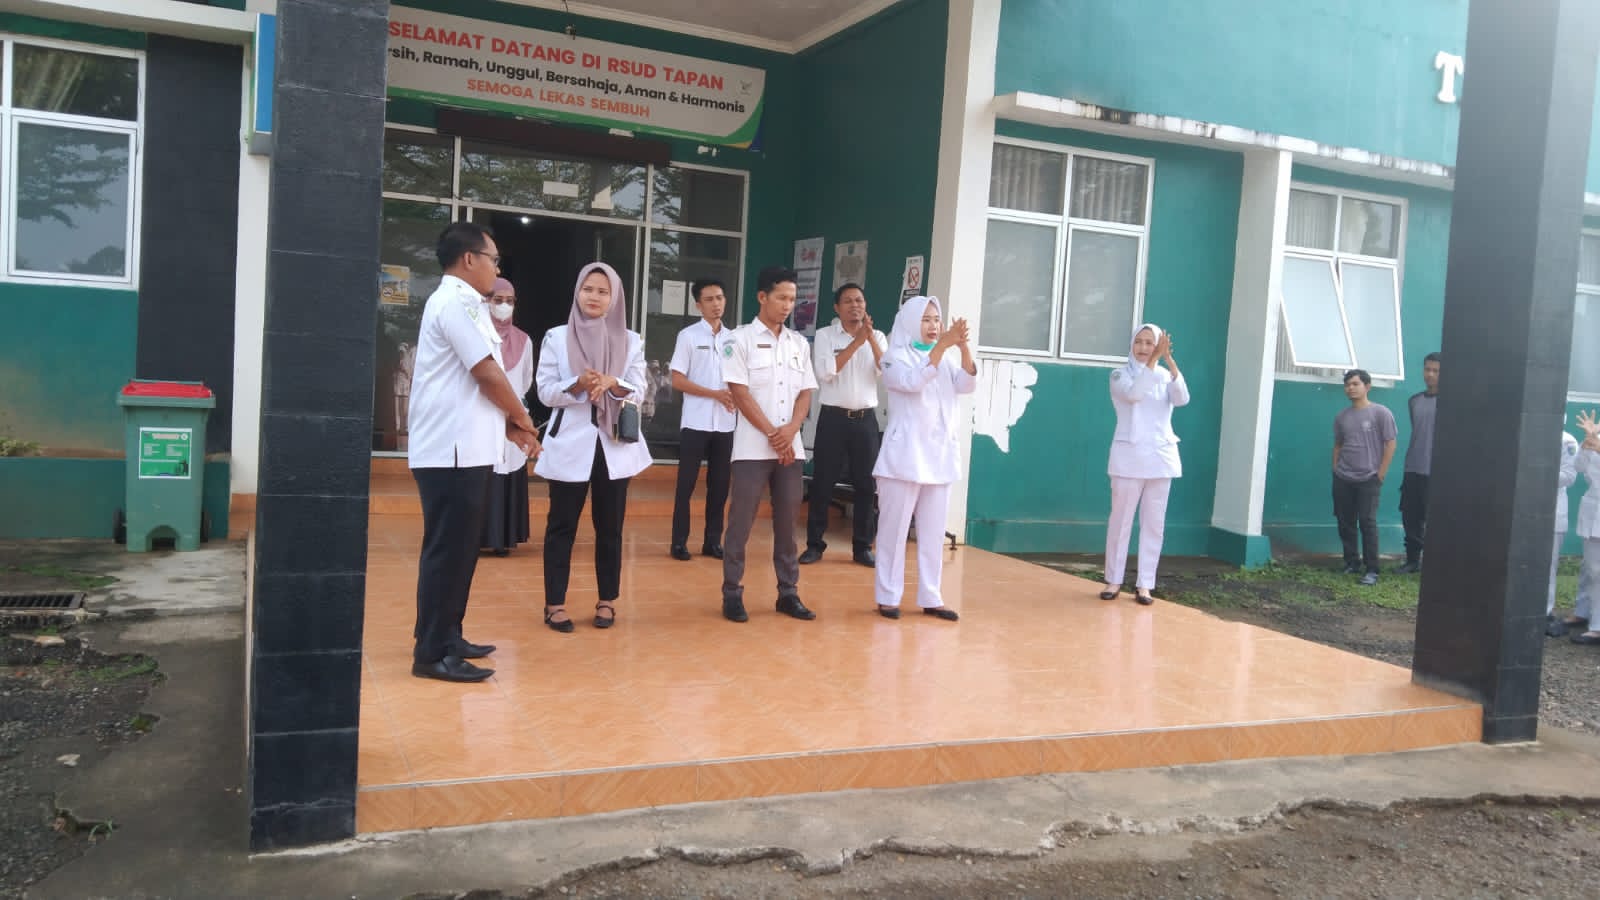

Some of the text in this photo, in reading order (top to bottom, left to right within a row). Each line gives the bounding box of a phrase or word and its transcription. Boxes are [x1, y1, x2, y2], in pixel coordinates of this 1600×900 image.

[389, 21, 724, 91] SELAMAT DATANG DI RSUD TAPAN
[423, 52, 482, 72] Ramah,
[486, 61, 542, 81] Unggul,
[546, 70, 621, 94] Bersahaja,
[624, 84, 667, 101] Aman
[668, 91, 679, 103] &
[681, 92, 746, 113] Harmonis
[467, 79, 650, 118] SEMOGA LEKAS SEMBUH
